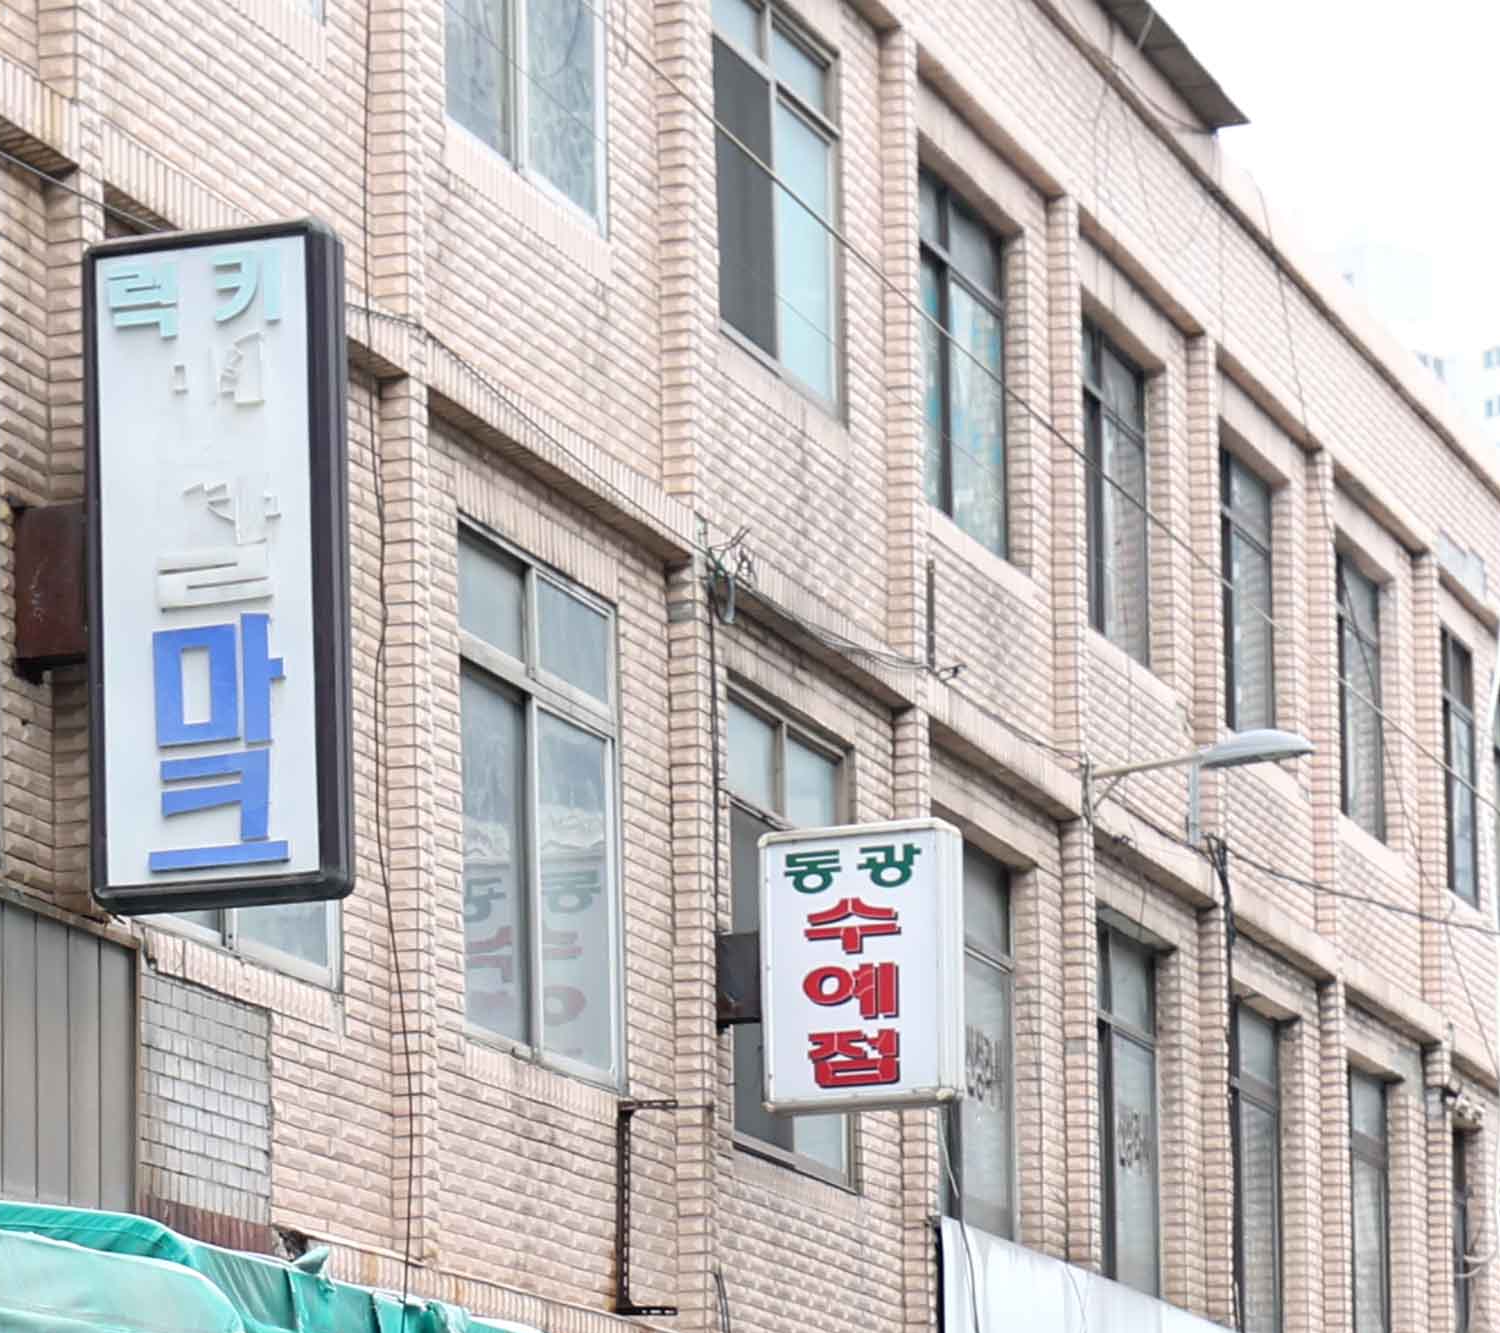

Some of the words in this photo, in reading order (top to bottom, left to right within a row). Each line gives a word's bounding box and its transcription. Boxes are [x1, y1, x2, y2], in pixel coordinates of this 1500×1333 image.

[107, 246, 281, 340] 럭키
[784, 843, 921, 893] 동광
[803, 897, 902, 1088] 수예점
